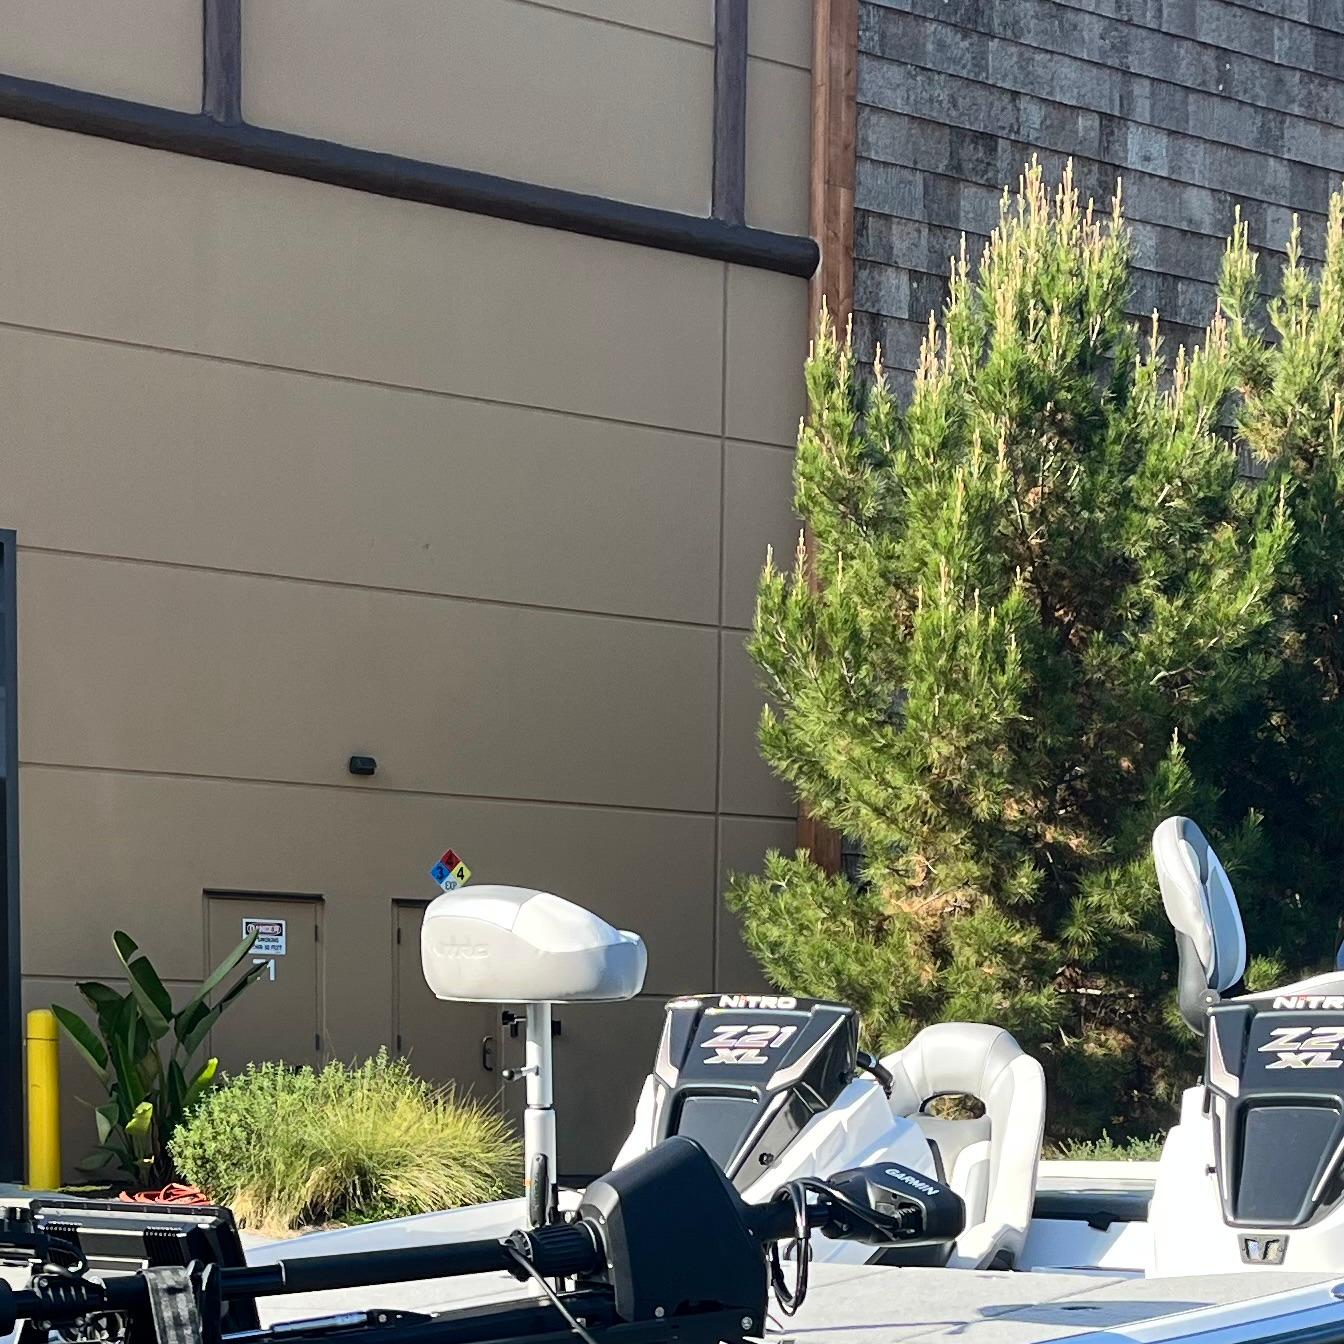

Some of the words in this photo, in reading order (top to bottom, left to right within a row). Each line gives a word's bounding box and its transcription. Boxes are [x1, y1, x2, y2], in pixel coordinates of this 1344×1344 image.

[456, 866, 465, 880] 4
[719, 995, 797, 1009] NITRO
[701, 1026, 797, 1048] Z21
[704, 1048, 768, 1064] XL
[1265, 1052, 1343, 1069] XL
[885, 1168, 940, 1195] GARMIN
